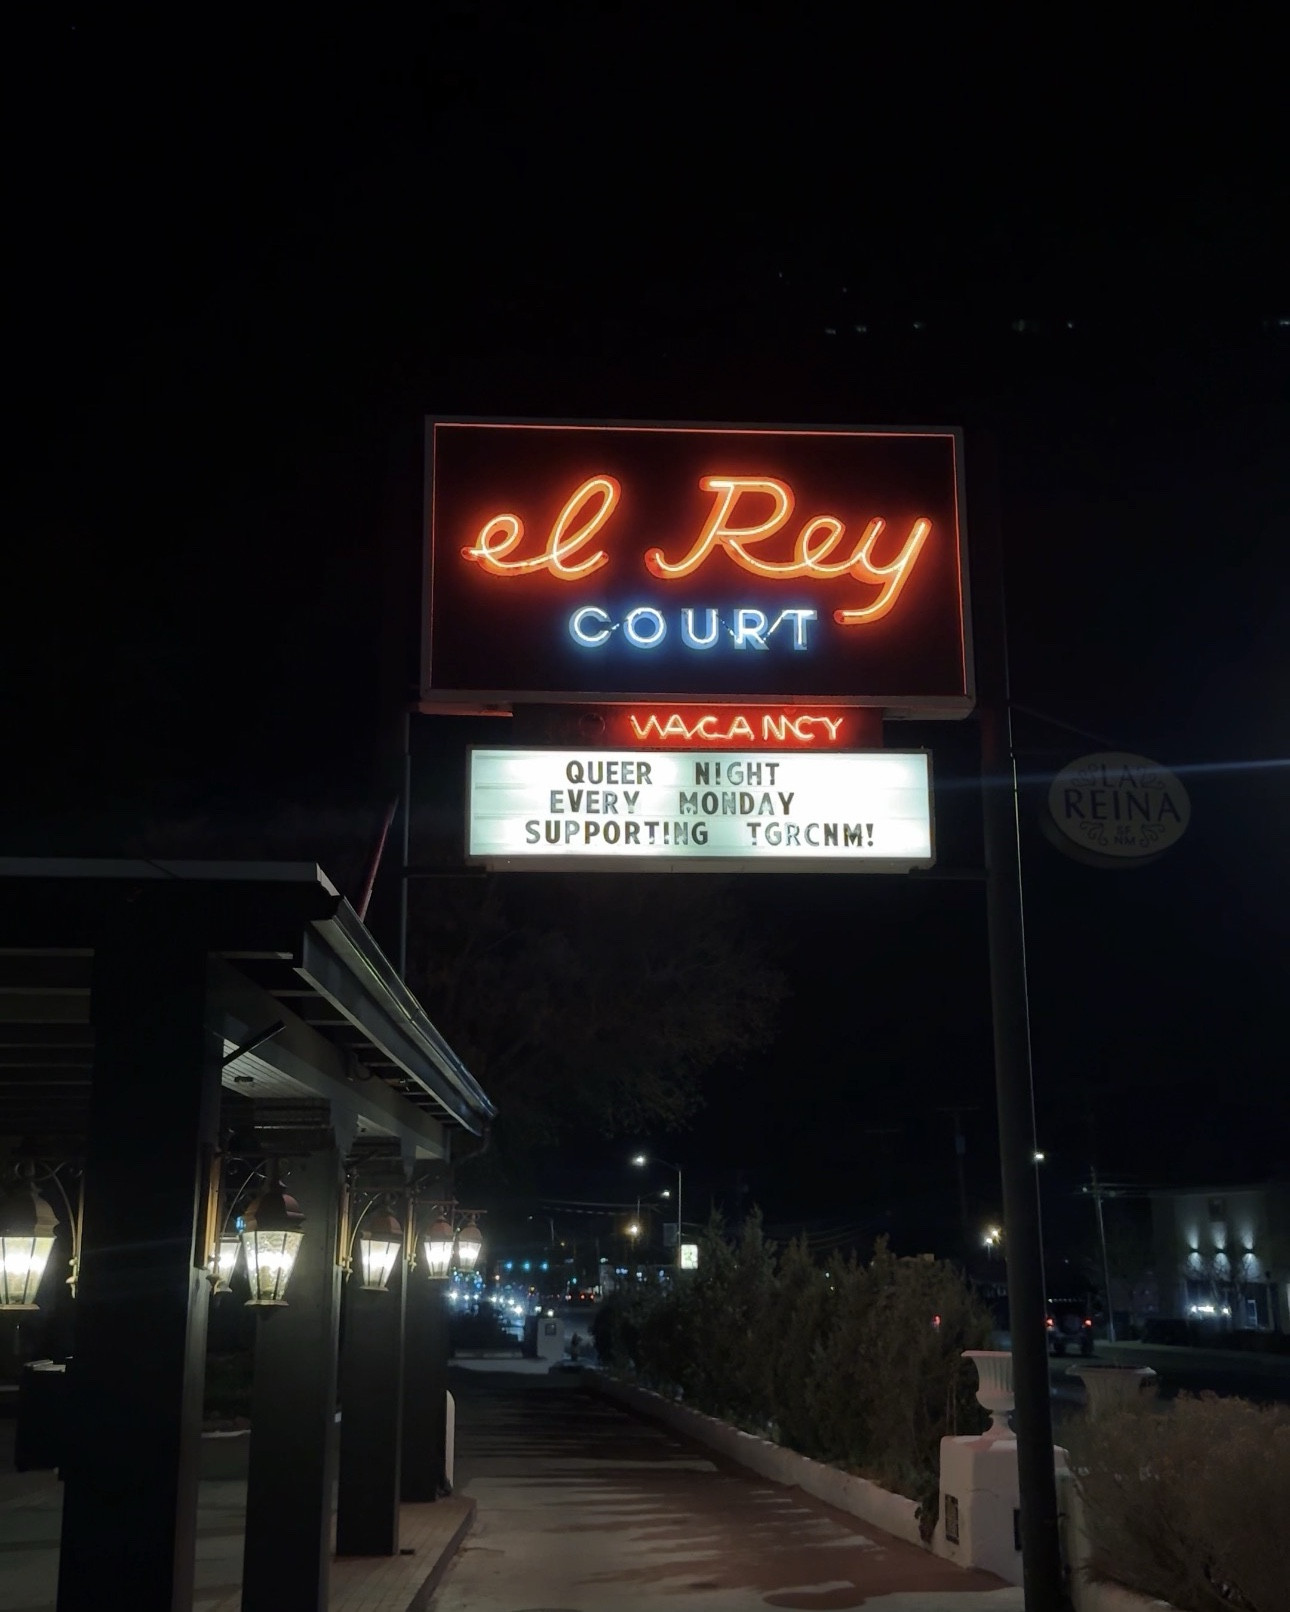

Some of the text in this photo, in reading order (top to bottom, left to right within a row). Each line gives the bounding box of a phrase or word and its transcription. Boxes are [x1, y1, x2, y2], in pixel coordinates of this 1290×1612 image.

[461, 473, 932, 626] el Rey
[568, 604, 818, 652] COURT
[630, 714, 844, 741] VACANCY
[566, 760, 781, 786] QUEER NIGHT
[1101, 764, 1138, 788] LA
[550, 790, 795, 815] EVERY MONDAY
[1063, 788, 1182, 824] REINA
[525, 820, 875, 847] SUPPORTING TGRCNM!
